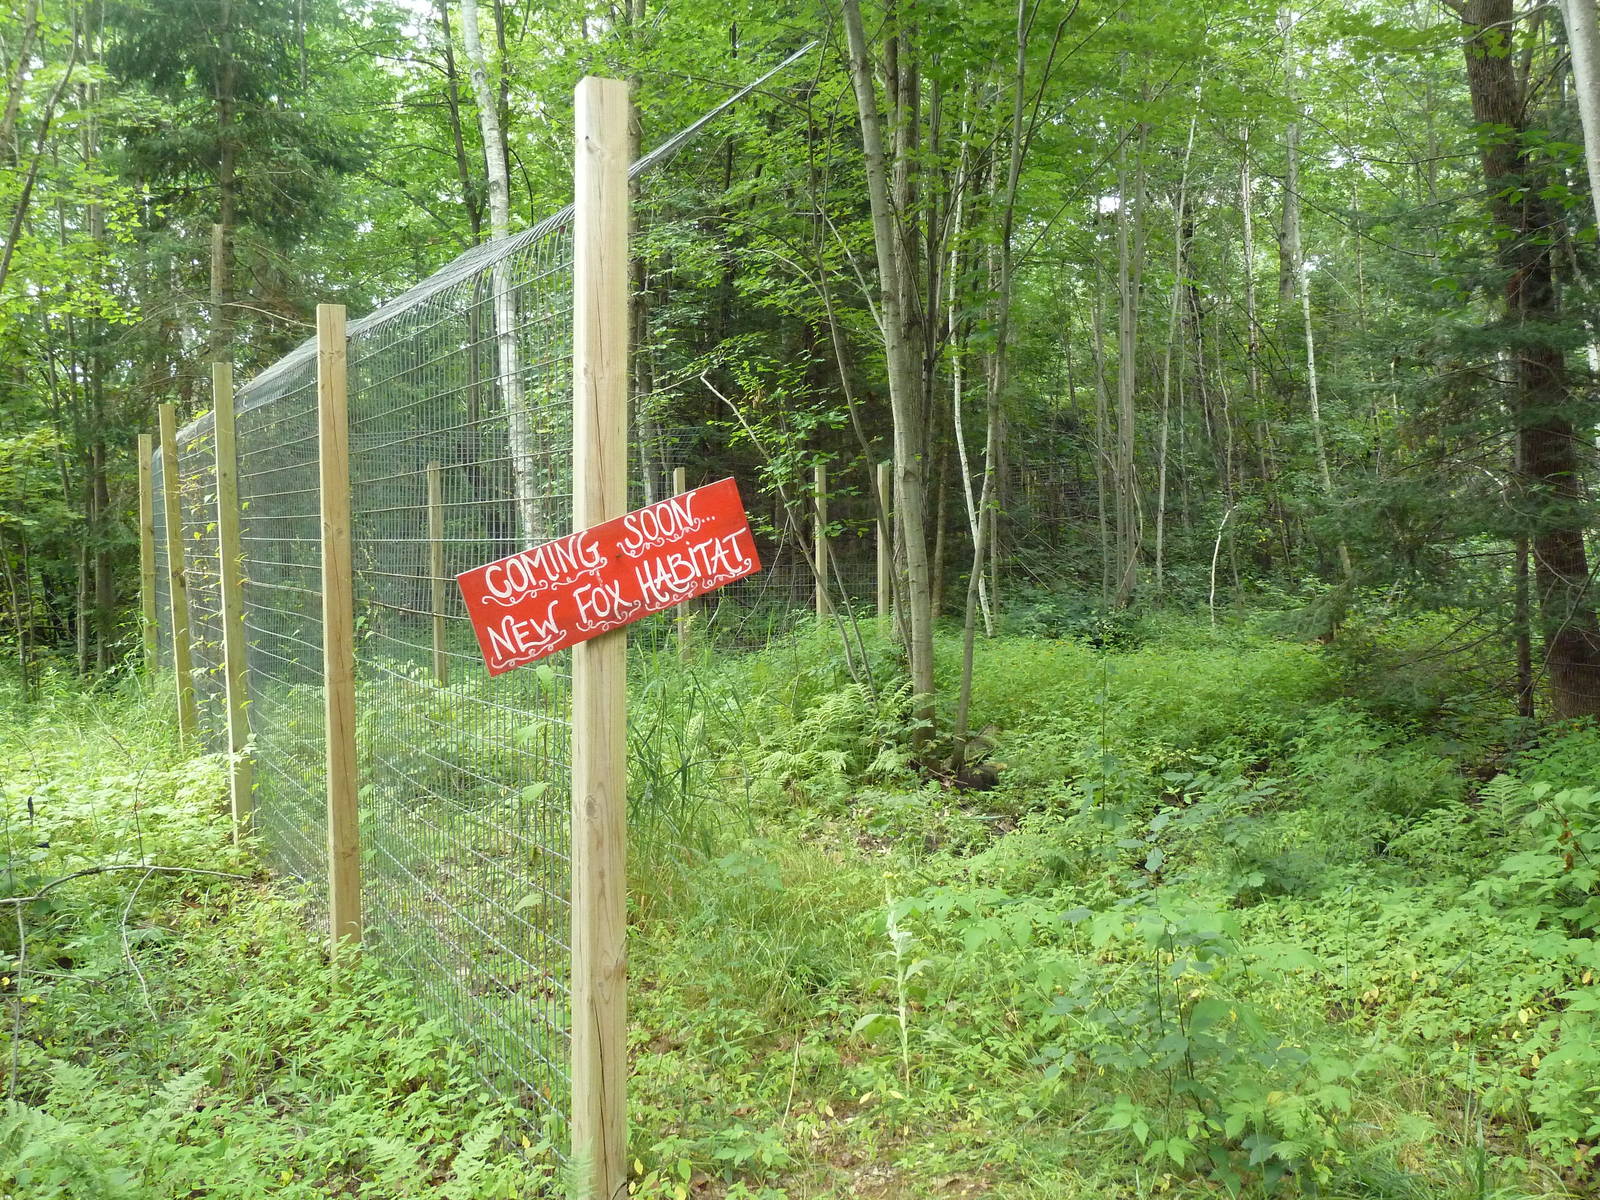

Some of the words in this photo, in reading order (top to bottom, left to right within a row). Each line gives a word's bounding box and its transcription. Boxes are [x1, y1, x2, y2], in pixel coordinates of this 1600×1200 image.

[484, 531, 606, 602] COMING
[619, 492, 717, 555] SOON...
[487, 600, 561, 663] NEW
[573, 579, 634, 626] FOX
